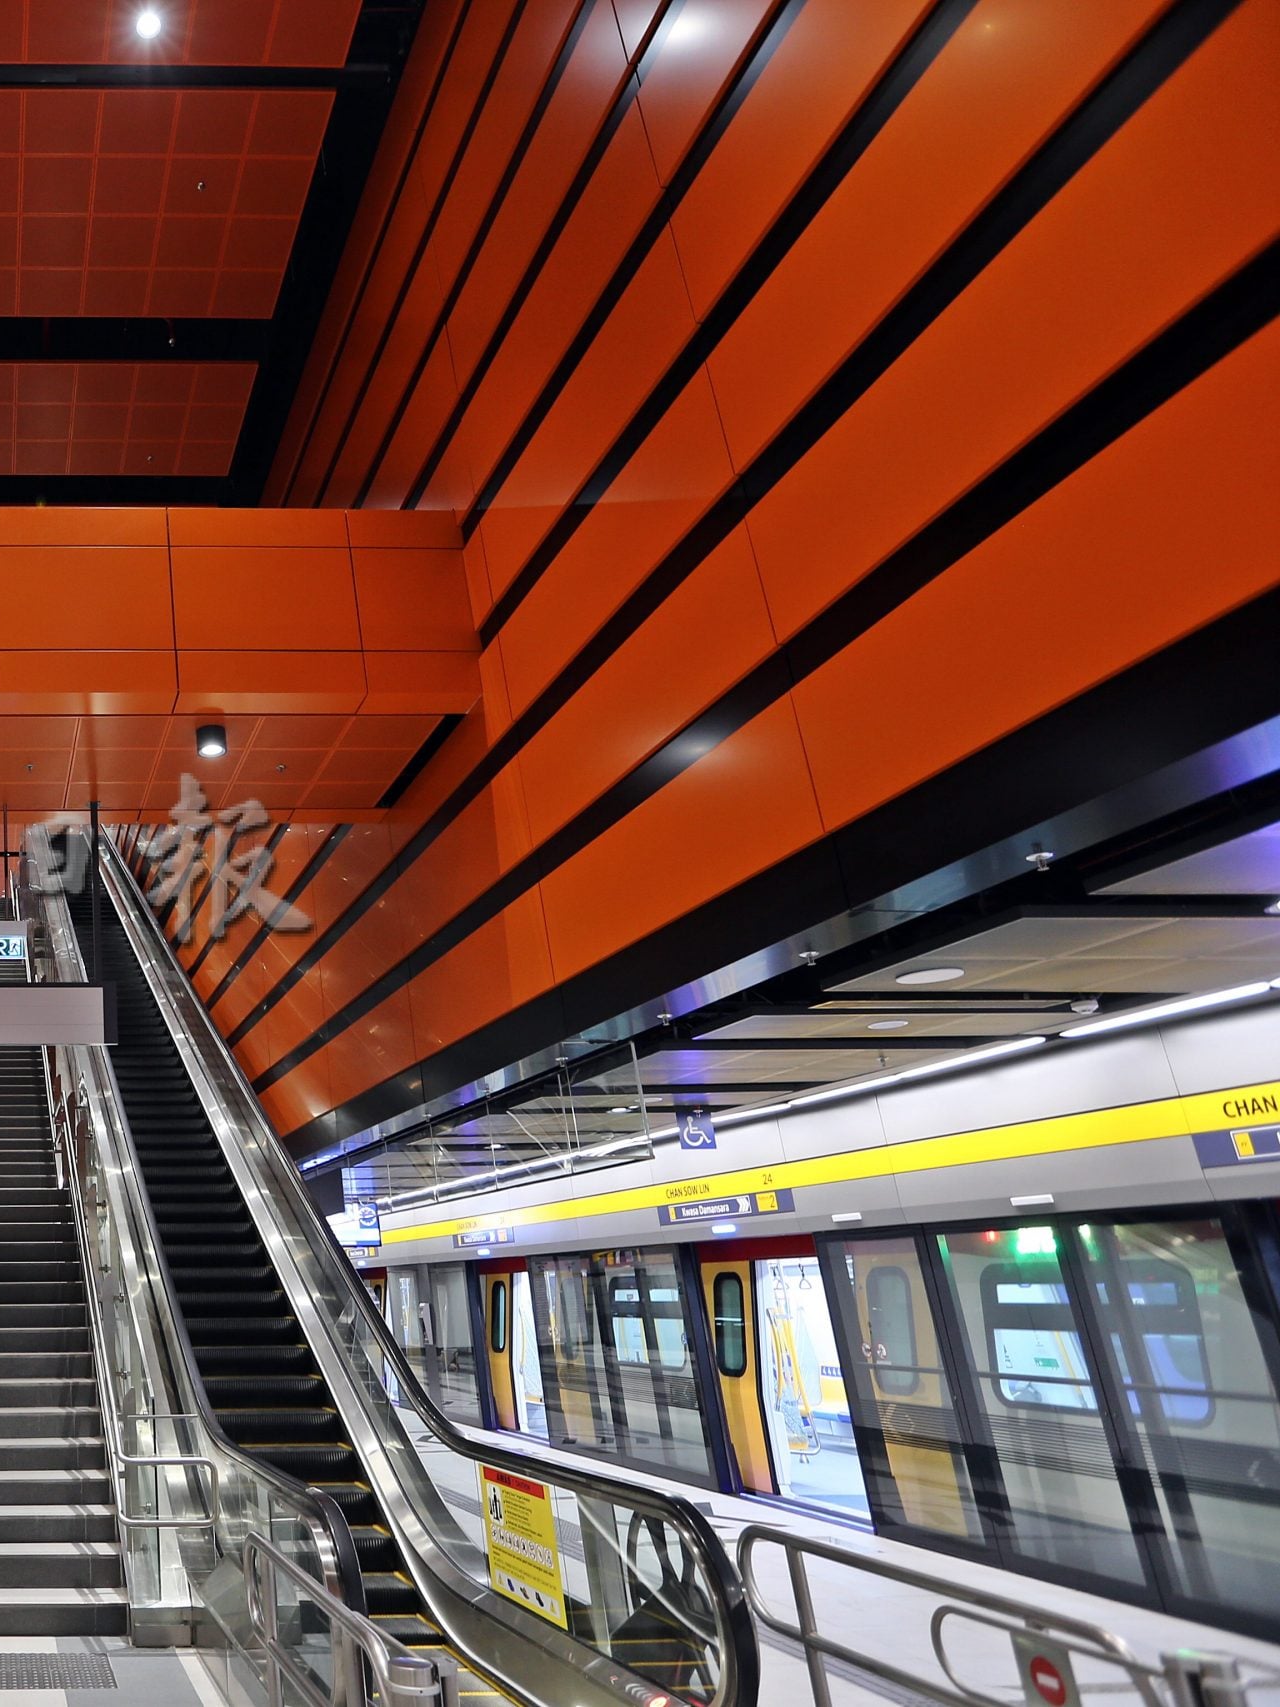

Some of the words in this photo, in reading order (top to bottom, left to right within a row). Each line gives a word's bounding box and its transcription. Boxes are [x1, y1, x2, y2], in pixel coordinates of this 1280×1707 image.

[1222, 1094, 1278, 1119] CHAN
[665, 1187, 683, 1199] CHAN
[684, 1185, 699, 1197] SOW
[699, 1183, 710, 1194] LIN
[762, 1173, 773, 1185] 24
[681, 1206, 699, 1217] Kwasa
[699, 1203, 730, 1215] Damansara
